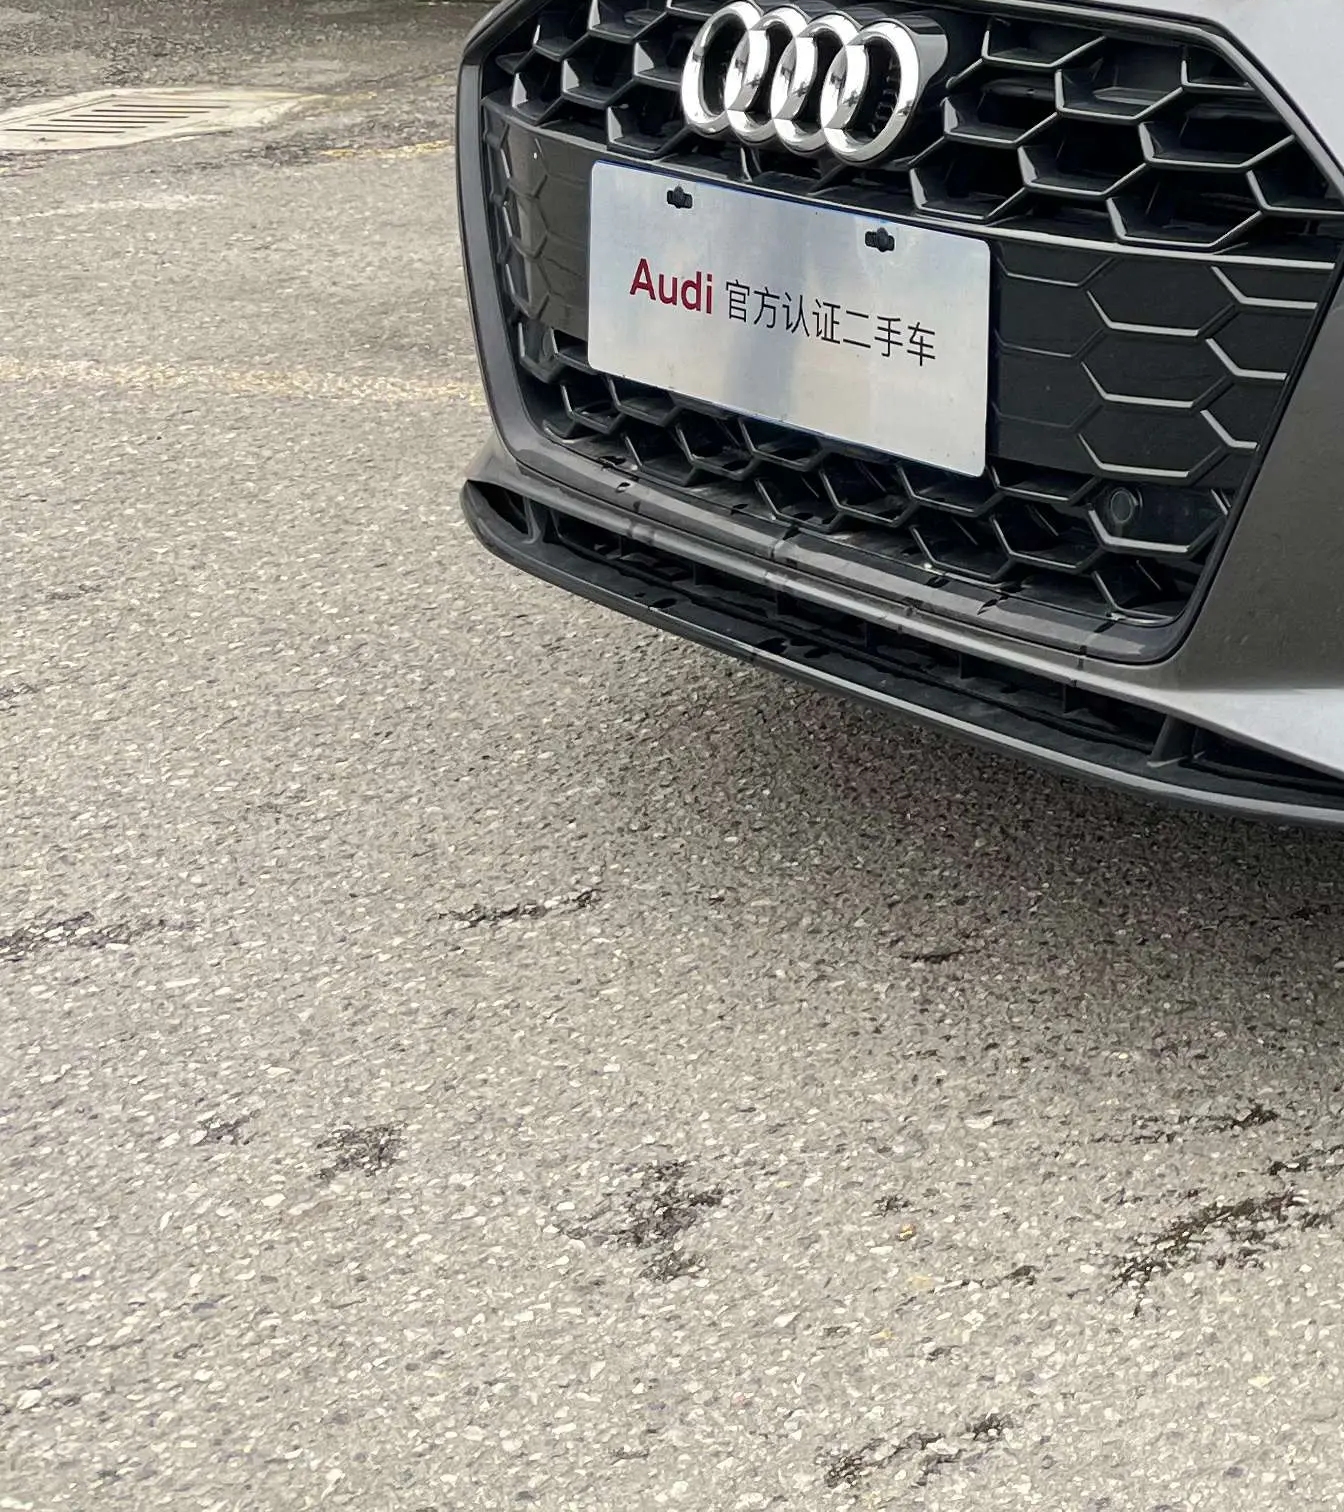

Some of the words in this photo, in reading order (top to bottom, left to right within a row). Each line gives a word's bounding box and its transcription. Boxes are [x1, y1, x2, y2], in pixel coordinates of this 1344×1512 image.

[629, 258, 713, 314] Audi
[725, 279, 936, 367] 官方认证二手车
